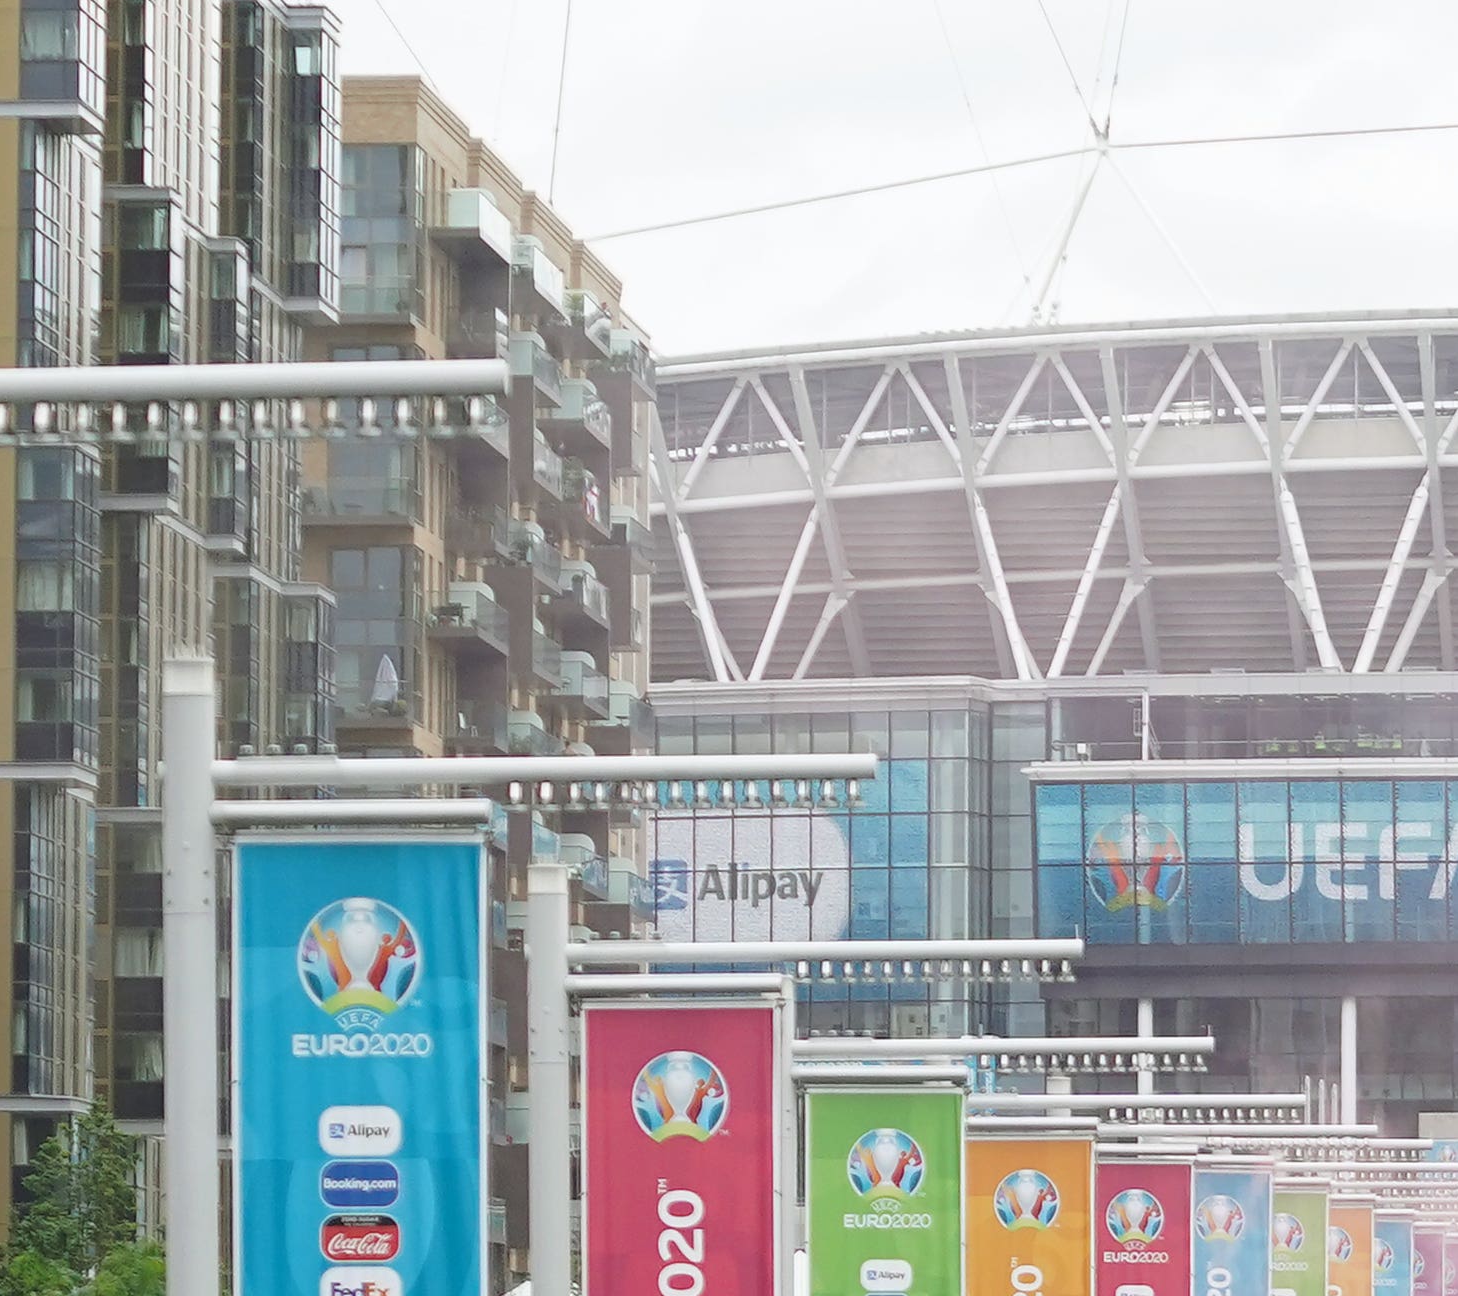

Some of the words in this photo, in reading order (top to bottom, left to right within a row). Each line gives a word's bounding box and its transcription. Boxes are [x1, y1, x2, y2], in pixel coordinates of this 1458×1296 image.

[697, 862, 824, 907] Alipay
[292, 1033, 433, 1057] EURO2020
[347, 1124, 390, 1138] Alipay
[323, 1177, 396, 1190] Booking.com
